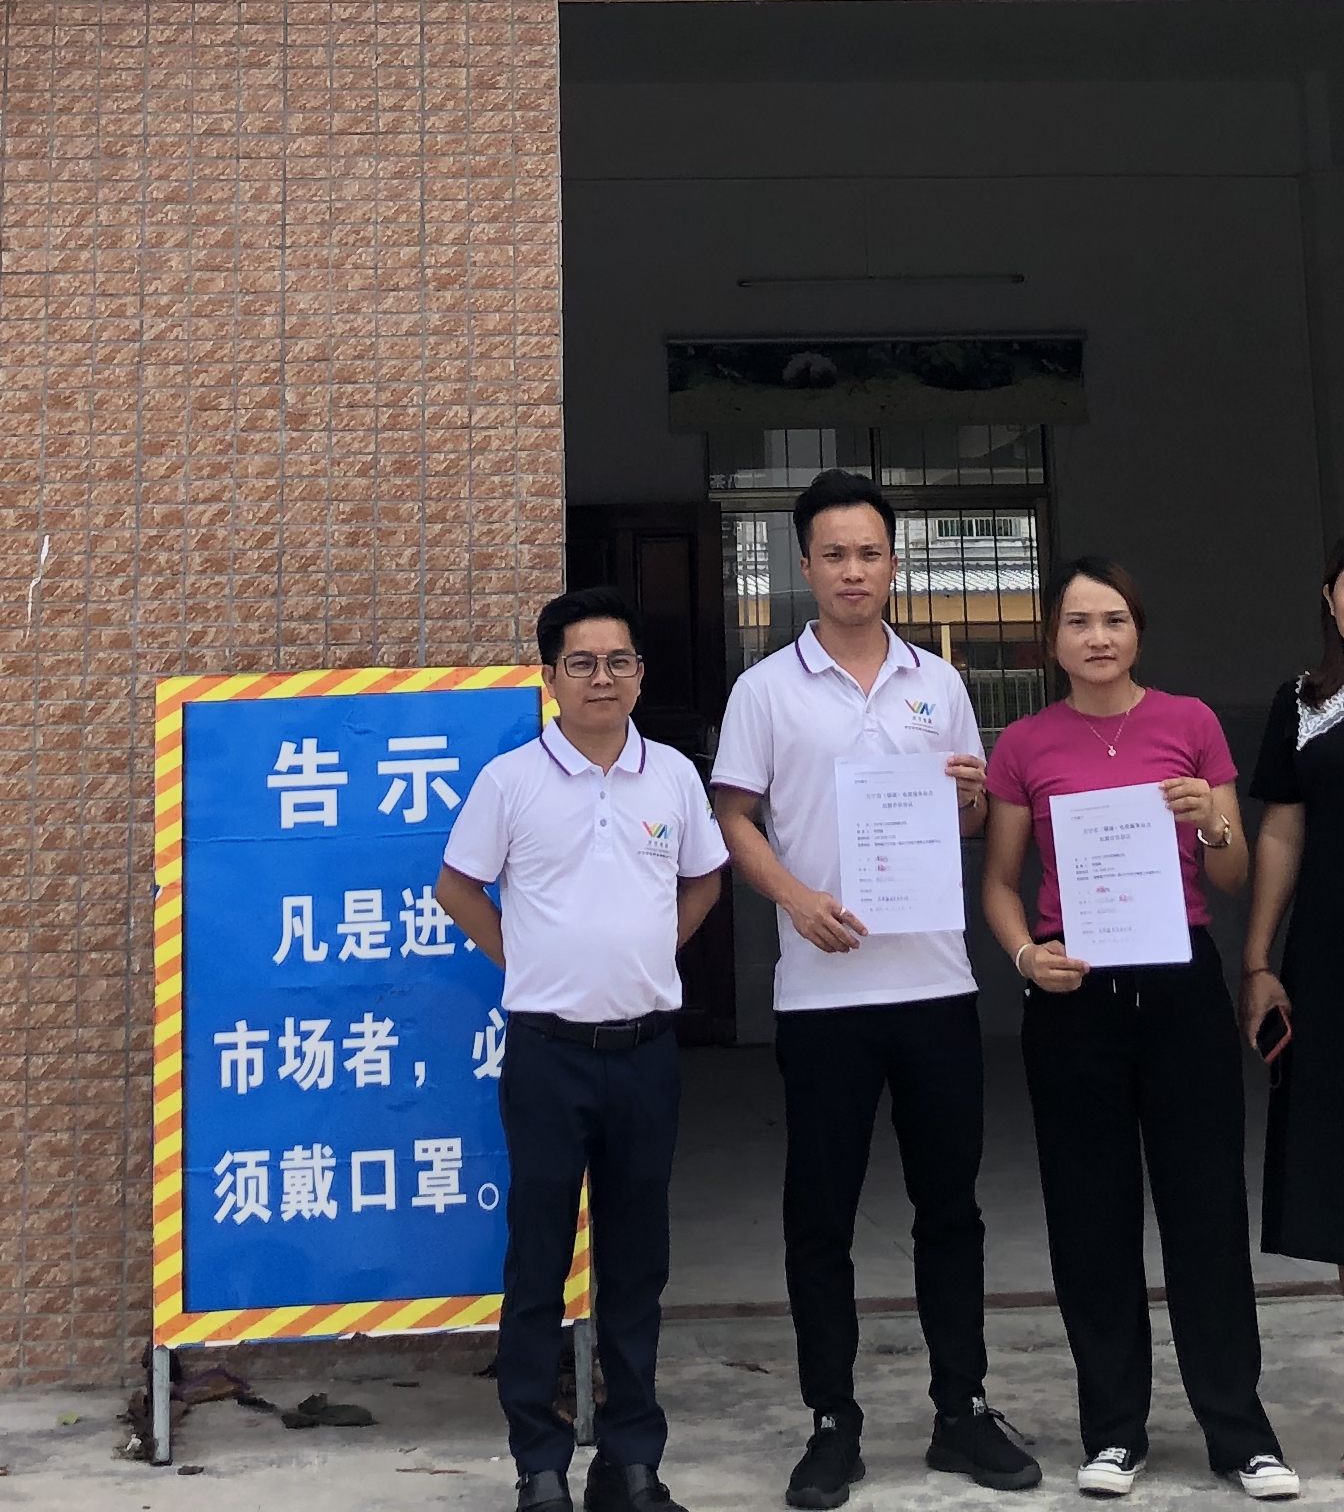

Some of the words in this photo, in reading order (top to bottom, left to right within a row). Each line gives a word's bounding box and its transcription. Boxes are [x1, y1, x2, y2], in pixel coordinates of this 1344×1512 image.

[267, 735, 462, 831] 告示
[272, 885, 477, 966] 凡是进
[213, 1136, 500, 1225] 须戴口罩。
